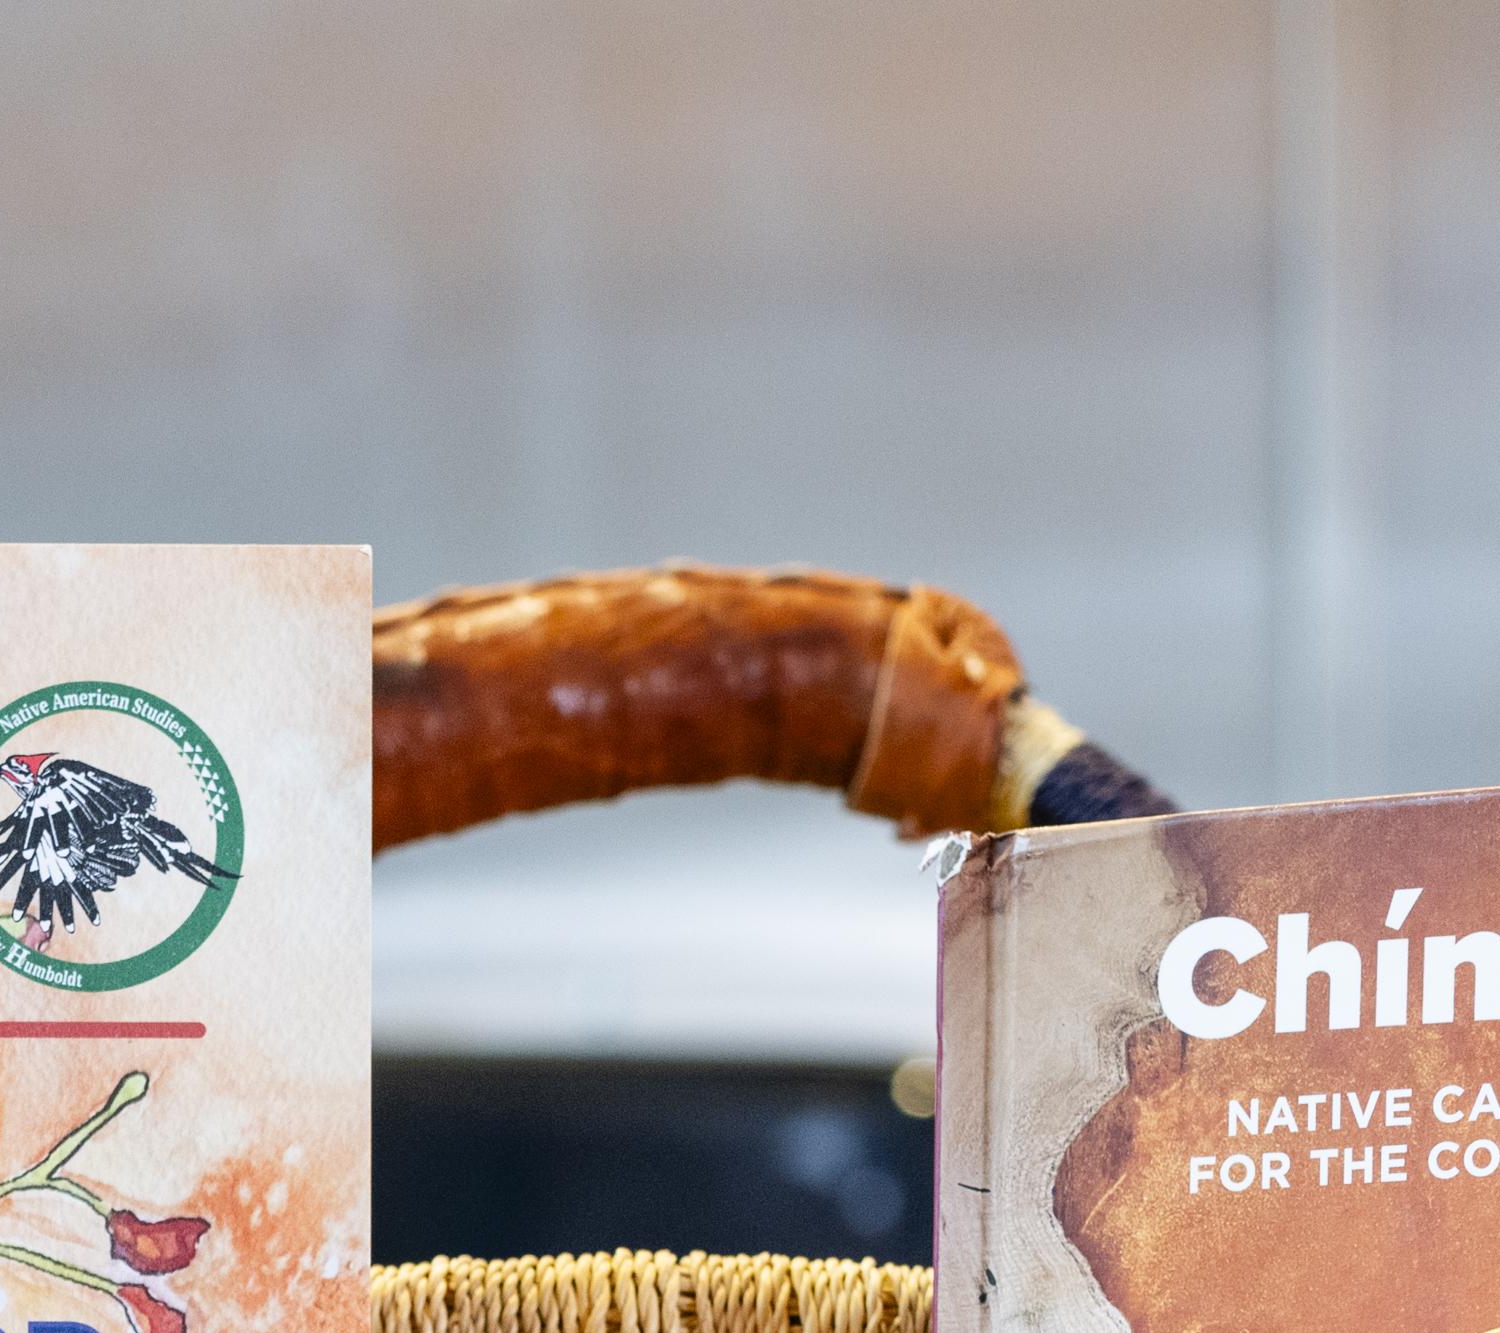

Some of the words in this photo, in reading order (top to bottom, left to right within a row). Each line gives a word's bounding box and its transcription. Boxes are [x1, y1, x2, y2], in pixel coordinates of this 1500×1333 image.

[52, 689, 130, 712] American
[131, 697, 186, 739] Studies
[4, 943, 82, 988] Humboldt
[1227, 1087, 1414, 1139] NATIVE
[1189, 1152, 1290, 1195] FOR
[1317, 1145, 1409, 1187] THE
